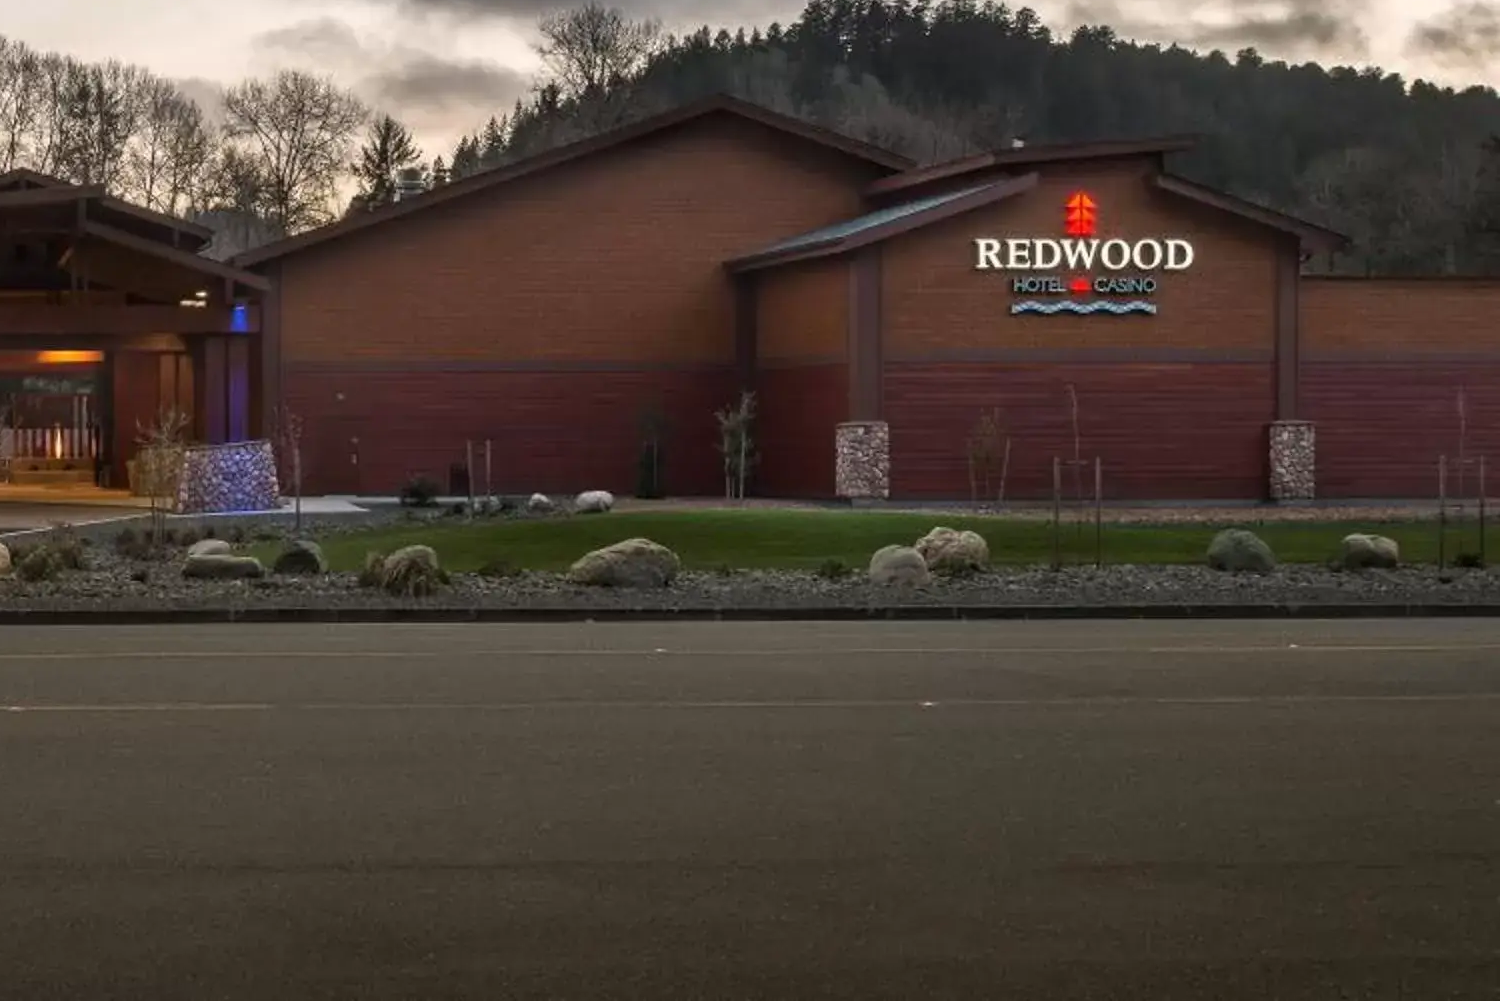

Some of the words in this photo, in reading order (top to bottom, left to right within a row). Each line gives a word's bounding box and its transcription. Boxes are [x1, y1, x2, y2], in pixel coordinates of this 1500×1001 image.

[975, 238, 1194, 270] REDWOOD
[1013, 277, 1066, 292] HOTEL
[1094, 277, 1156, 292] CASINO
